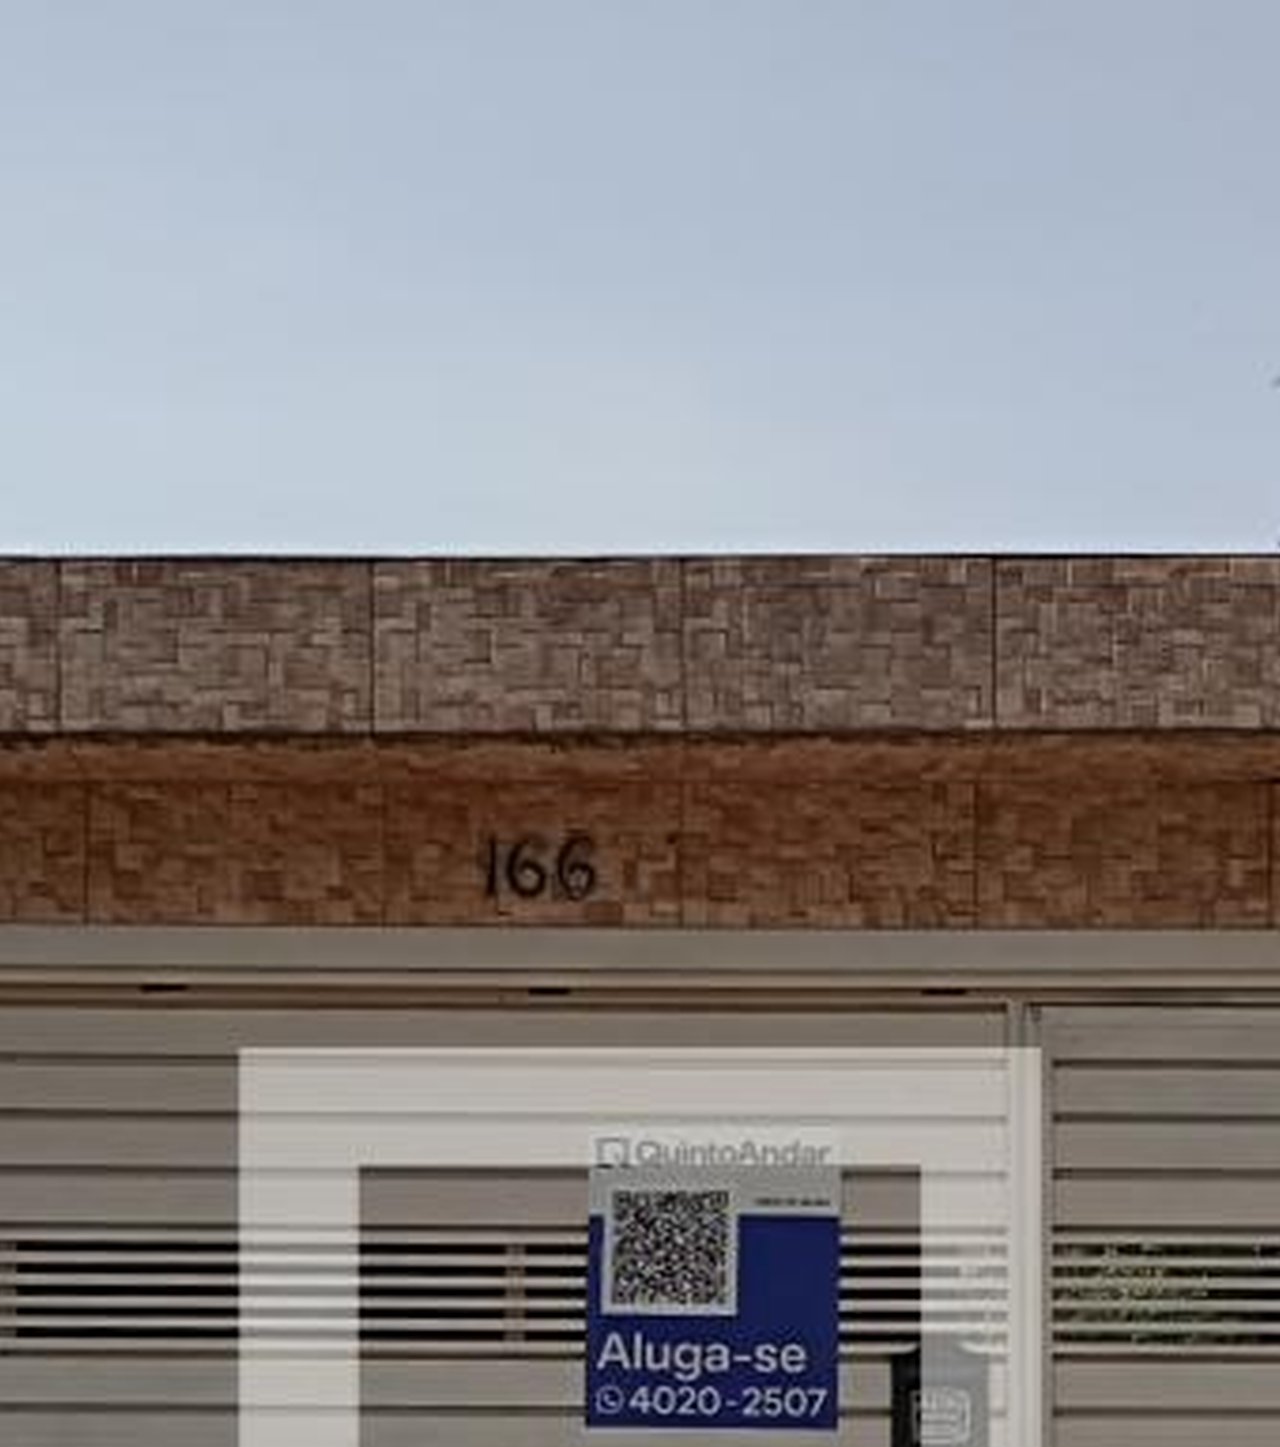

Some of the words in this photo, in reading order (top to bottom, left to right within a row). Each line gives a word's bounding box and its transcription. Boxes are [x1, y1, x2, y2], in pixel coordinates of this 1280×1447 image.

[486, 833, 595, 901] 166
[636, 1139, 832, 1168] QuintoAndar
[596, 1332, 808, 1381] Aluga-se
[629, 1386, 828, 1417] 4020-2507
